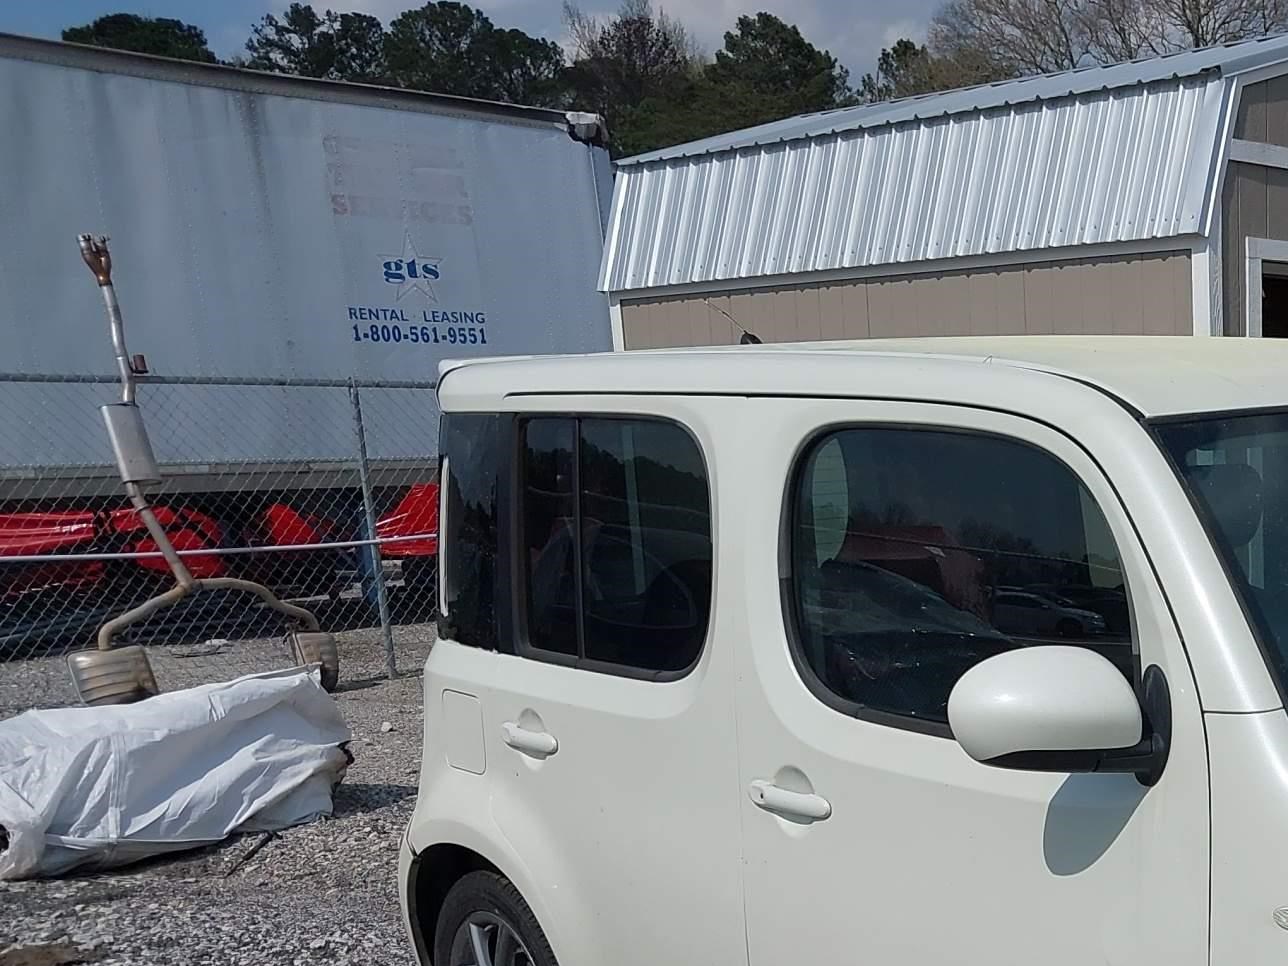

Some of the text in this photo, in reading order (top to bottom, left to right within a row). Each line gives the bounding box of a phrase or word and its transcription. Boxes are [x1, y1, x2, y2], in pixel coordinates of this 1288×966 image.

[383, 258, 440, 284] gts
[348, 307, 486, 324] RENTAL LEASING
[353, 325, 487, 344] 1-800-561-9551
